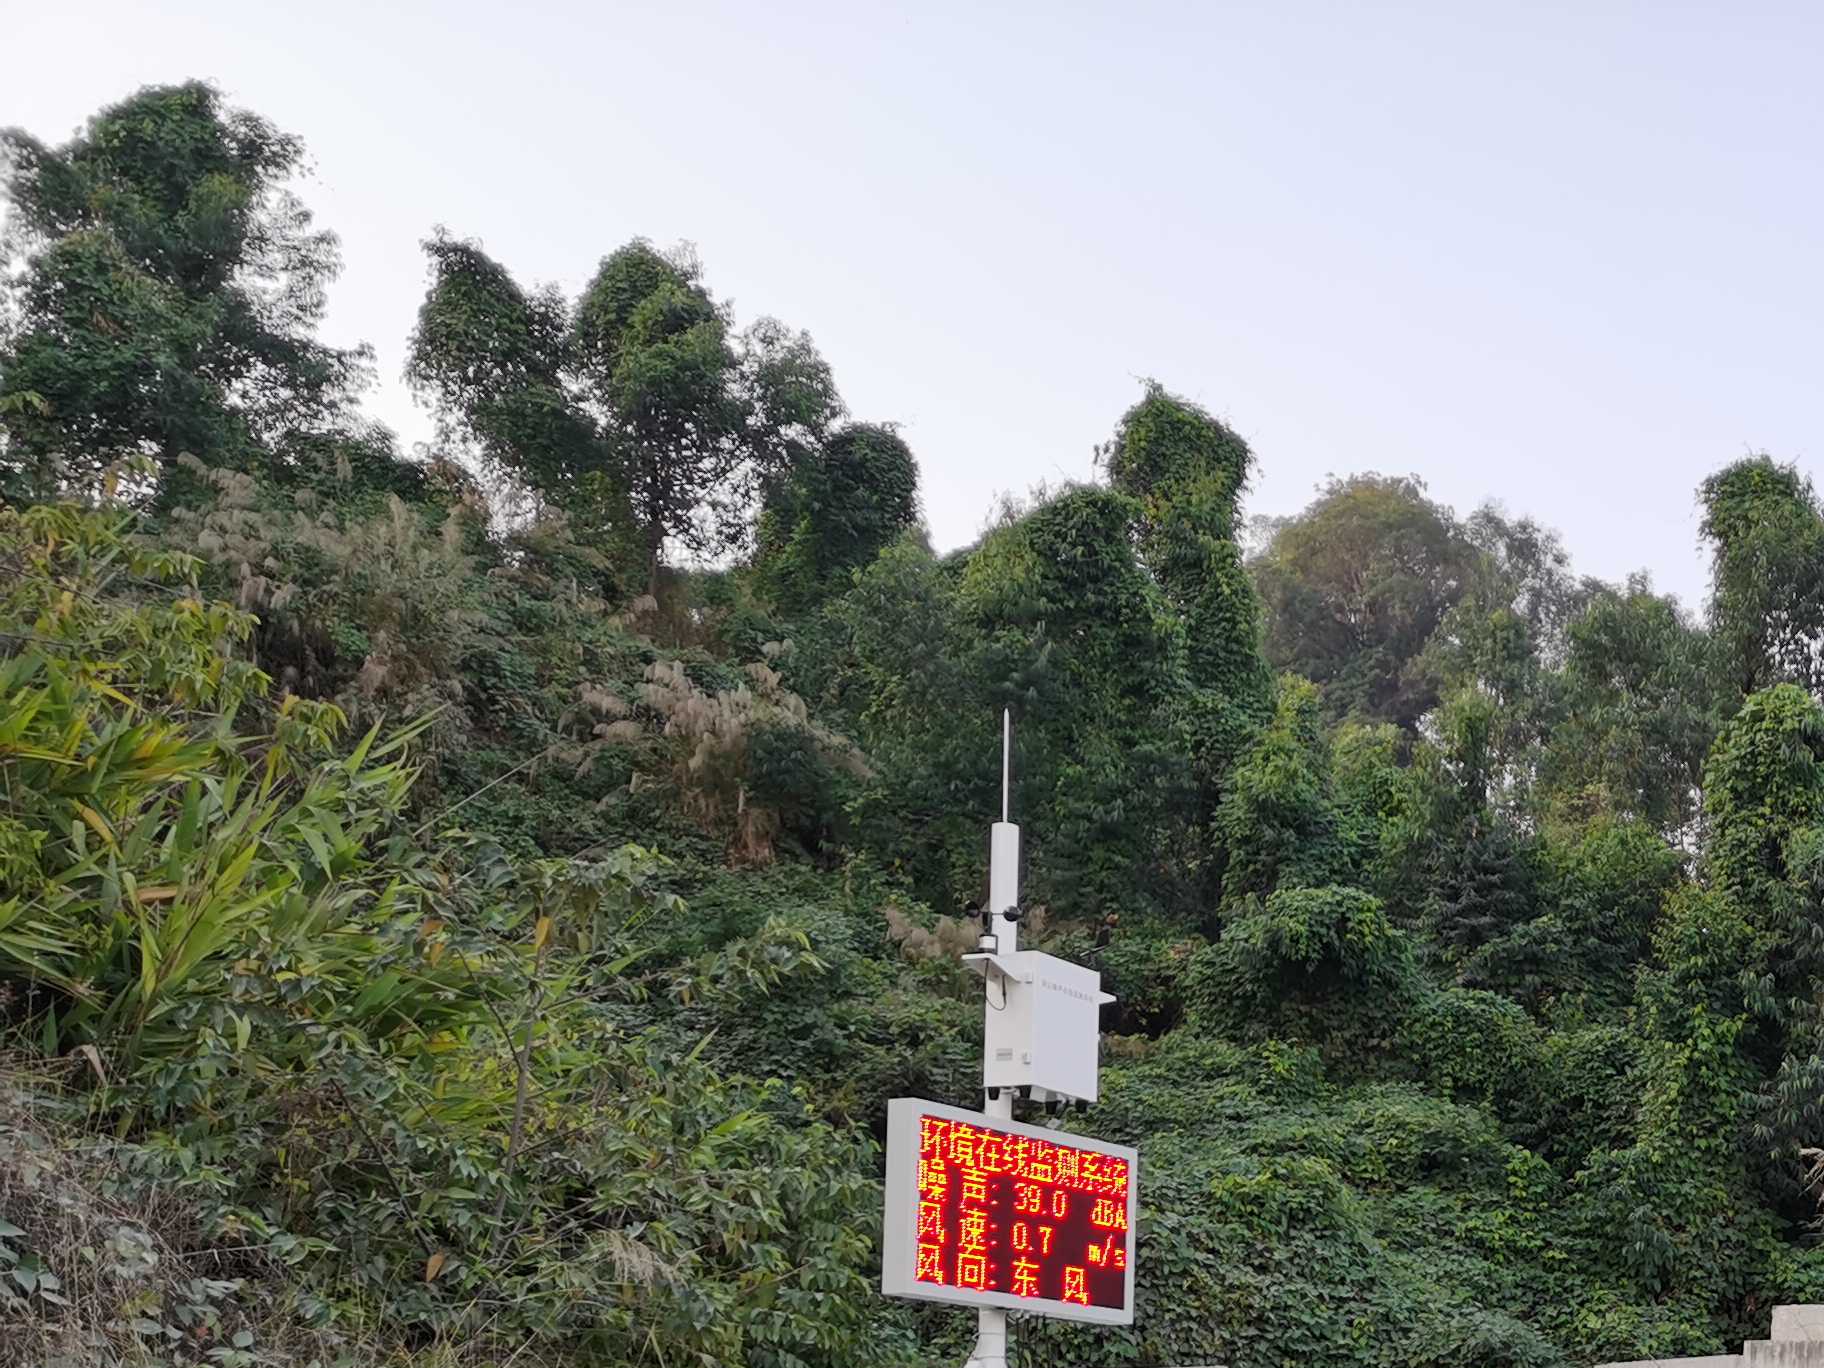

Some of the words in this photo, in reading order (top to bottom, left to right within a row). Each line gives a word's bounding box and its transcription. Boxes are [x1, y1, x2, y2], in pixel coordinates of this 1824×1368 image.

[919, 1117, 1129, 1197] 环境在线监测系统
[1013, 1182, 1068, 1218] 39.0
[1013, 1222, 1053, 1255] 0.7
